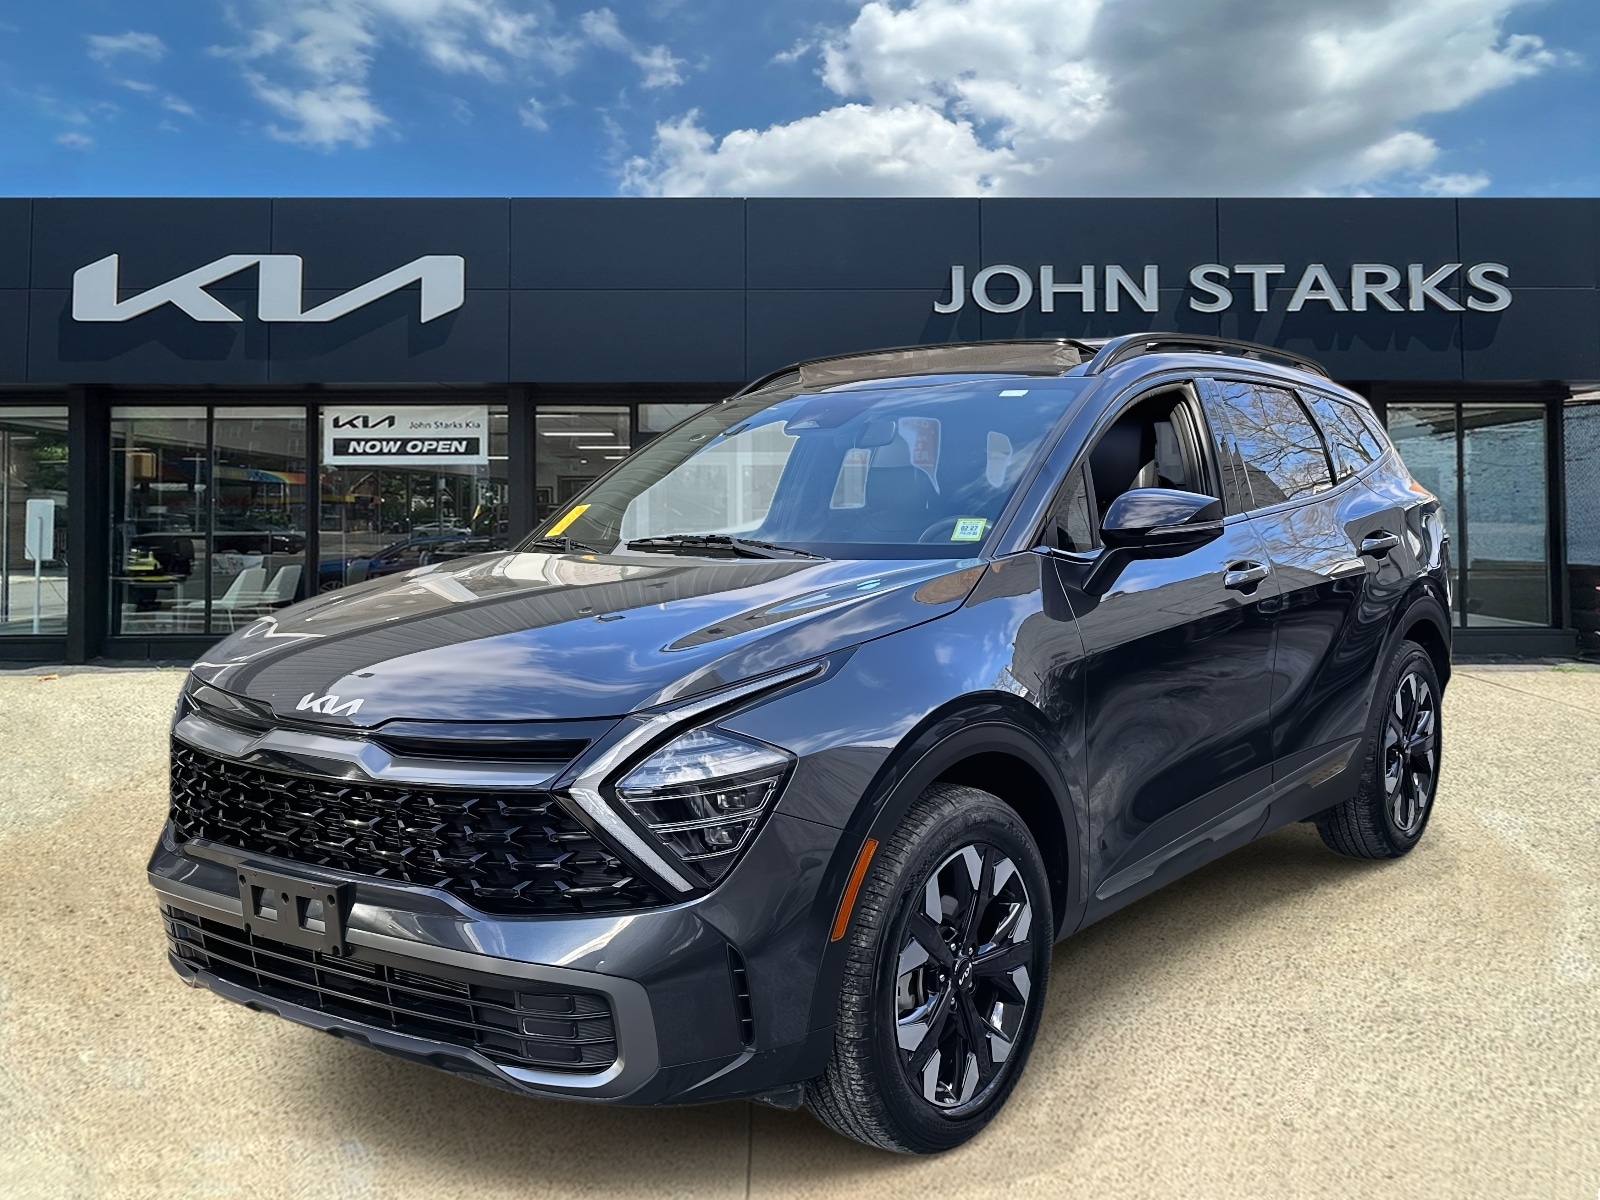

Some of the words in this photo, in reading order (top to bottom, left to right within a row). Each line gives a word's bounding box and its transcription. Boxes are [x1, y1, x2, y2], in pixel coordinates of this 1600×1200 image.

[72, 253, 465, 324] KIA
[933, 264, 1160, 314] JOHN
[1188, 262, 1513, 313] STARKS
[332, 415, 395, 429] KIA
[409, 421, 431, 430] John
[434, 421, 462, 430] Starks
[465, 421, 481, 429] Kia
[348, 440, 401, 453] NOW
[406, 440, 467, 453] OPEN
